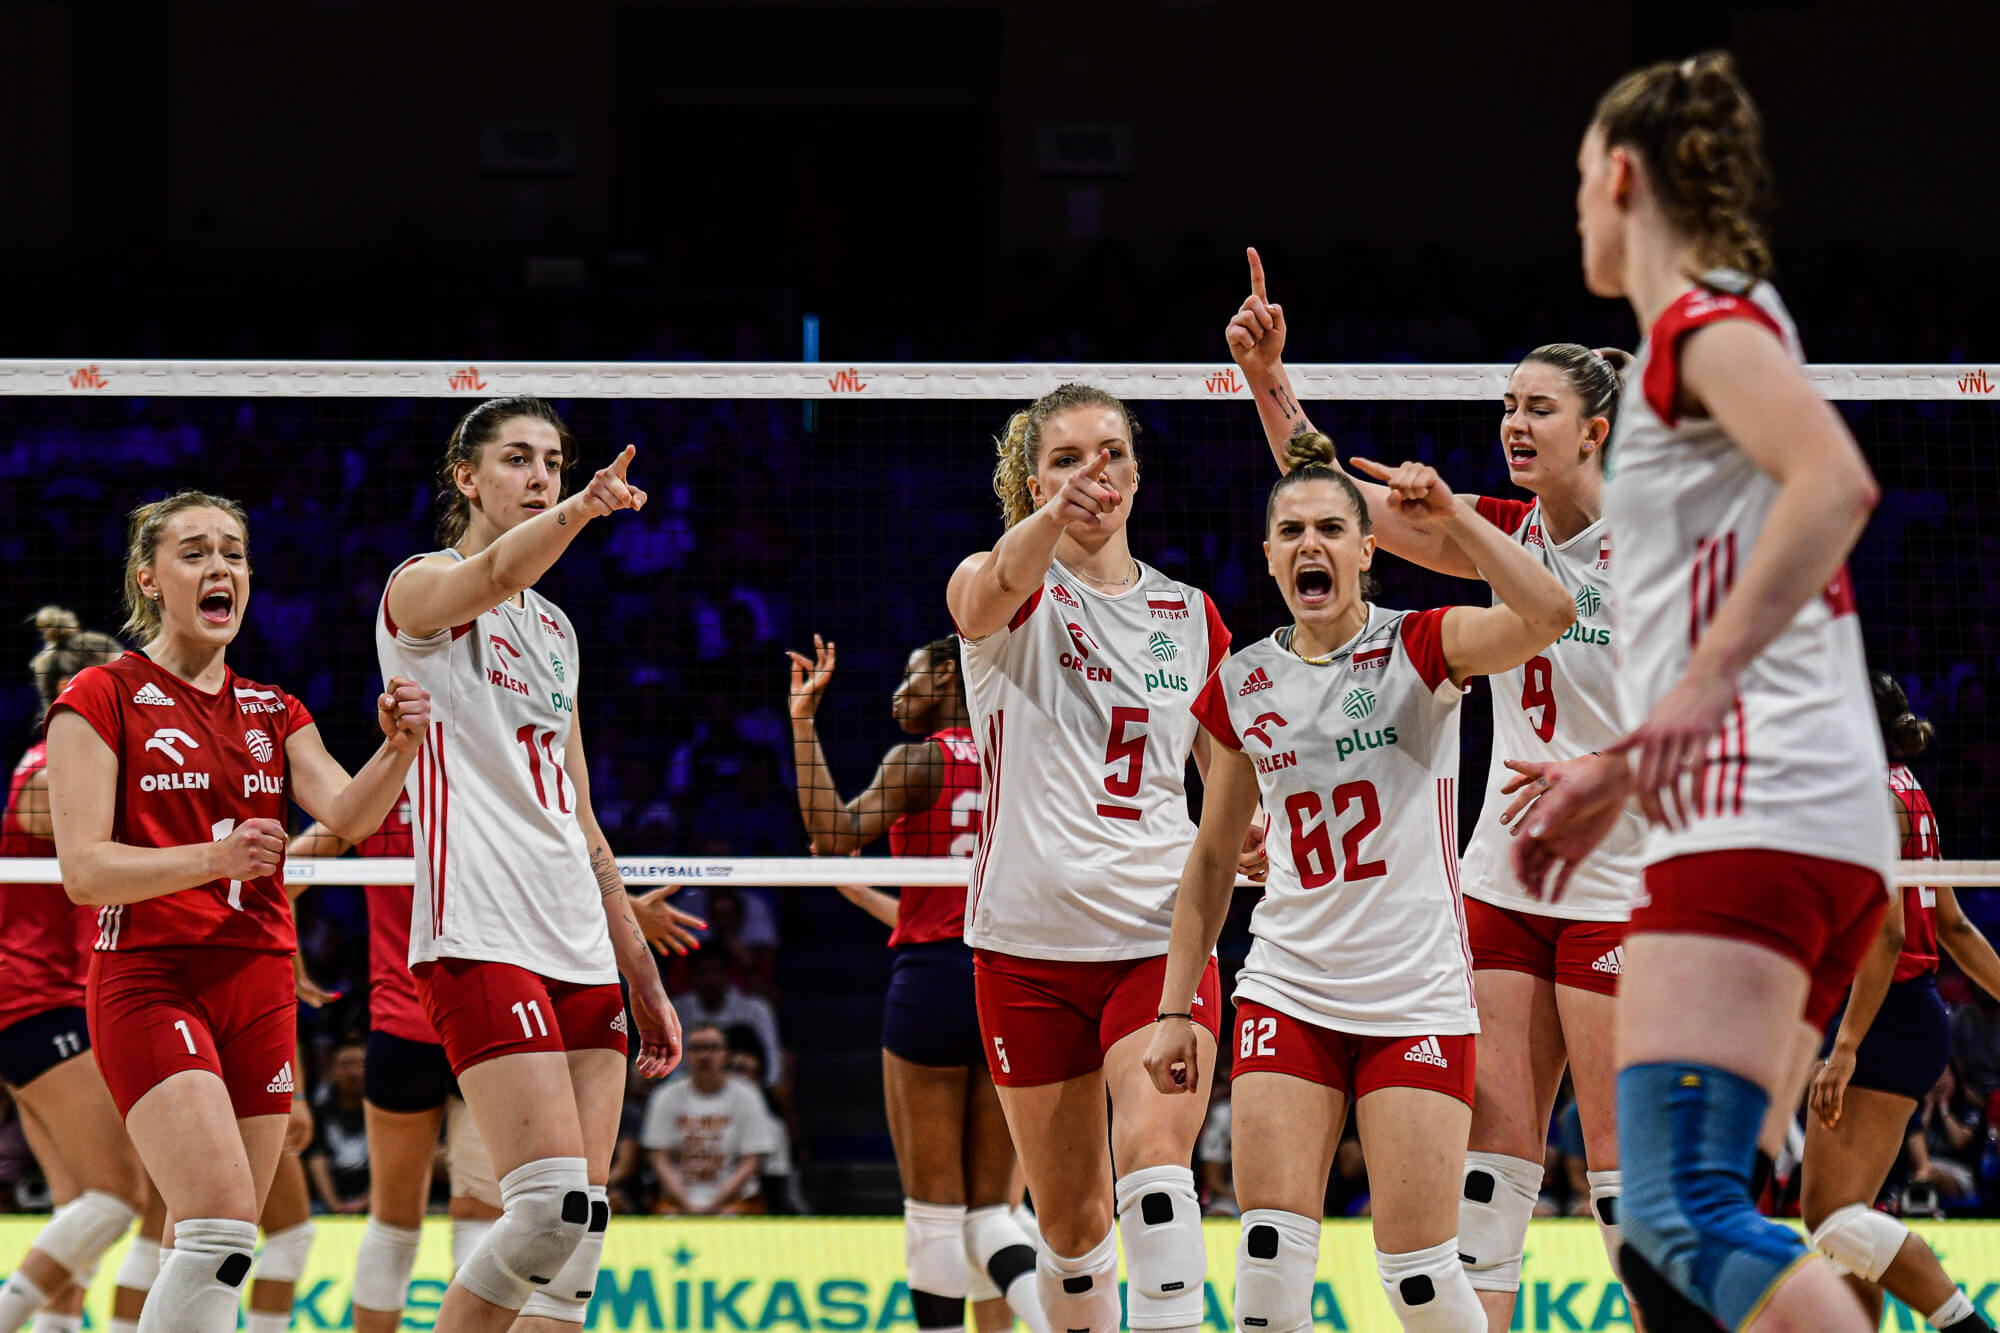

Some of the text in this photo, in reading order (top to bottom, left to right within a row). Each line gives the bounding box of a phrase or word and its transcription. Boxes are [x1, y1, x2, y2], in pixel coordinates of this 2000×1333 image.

[1151, 610, 1190, 620] POLSKA
[1059, 652, 1112, 682] OREN
[1144, 669, 1188, 692] plus
[1238, 680, 1274, 696] adidas
[133, 695, 175, 706] adidas
[241, 703, 286, 715] POLKA
[551, 689, 573, 712] plu
[1521, 655, 1556, 743] 9
[1103, 706, 1150, 798] 5
[1335, 727, 1398, 762] plus
[140, 772, 209, 792] ORLEN
[516, 724, 571, 814] 11
[1285, 779, 1387, 890] 62
[617, 866, 703, 877] OLLEYBALL
[511, 1000, 548, 1039] 11
[52, 1032, 80, 1058] 11
[174, 1020, 197, 1055] 1
[993, 1036, 1011, 1074] 5
[1403, 1051, 1448, 1069] adidas
